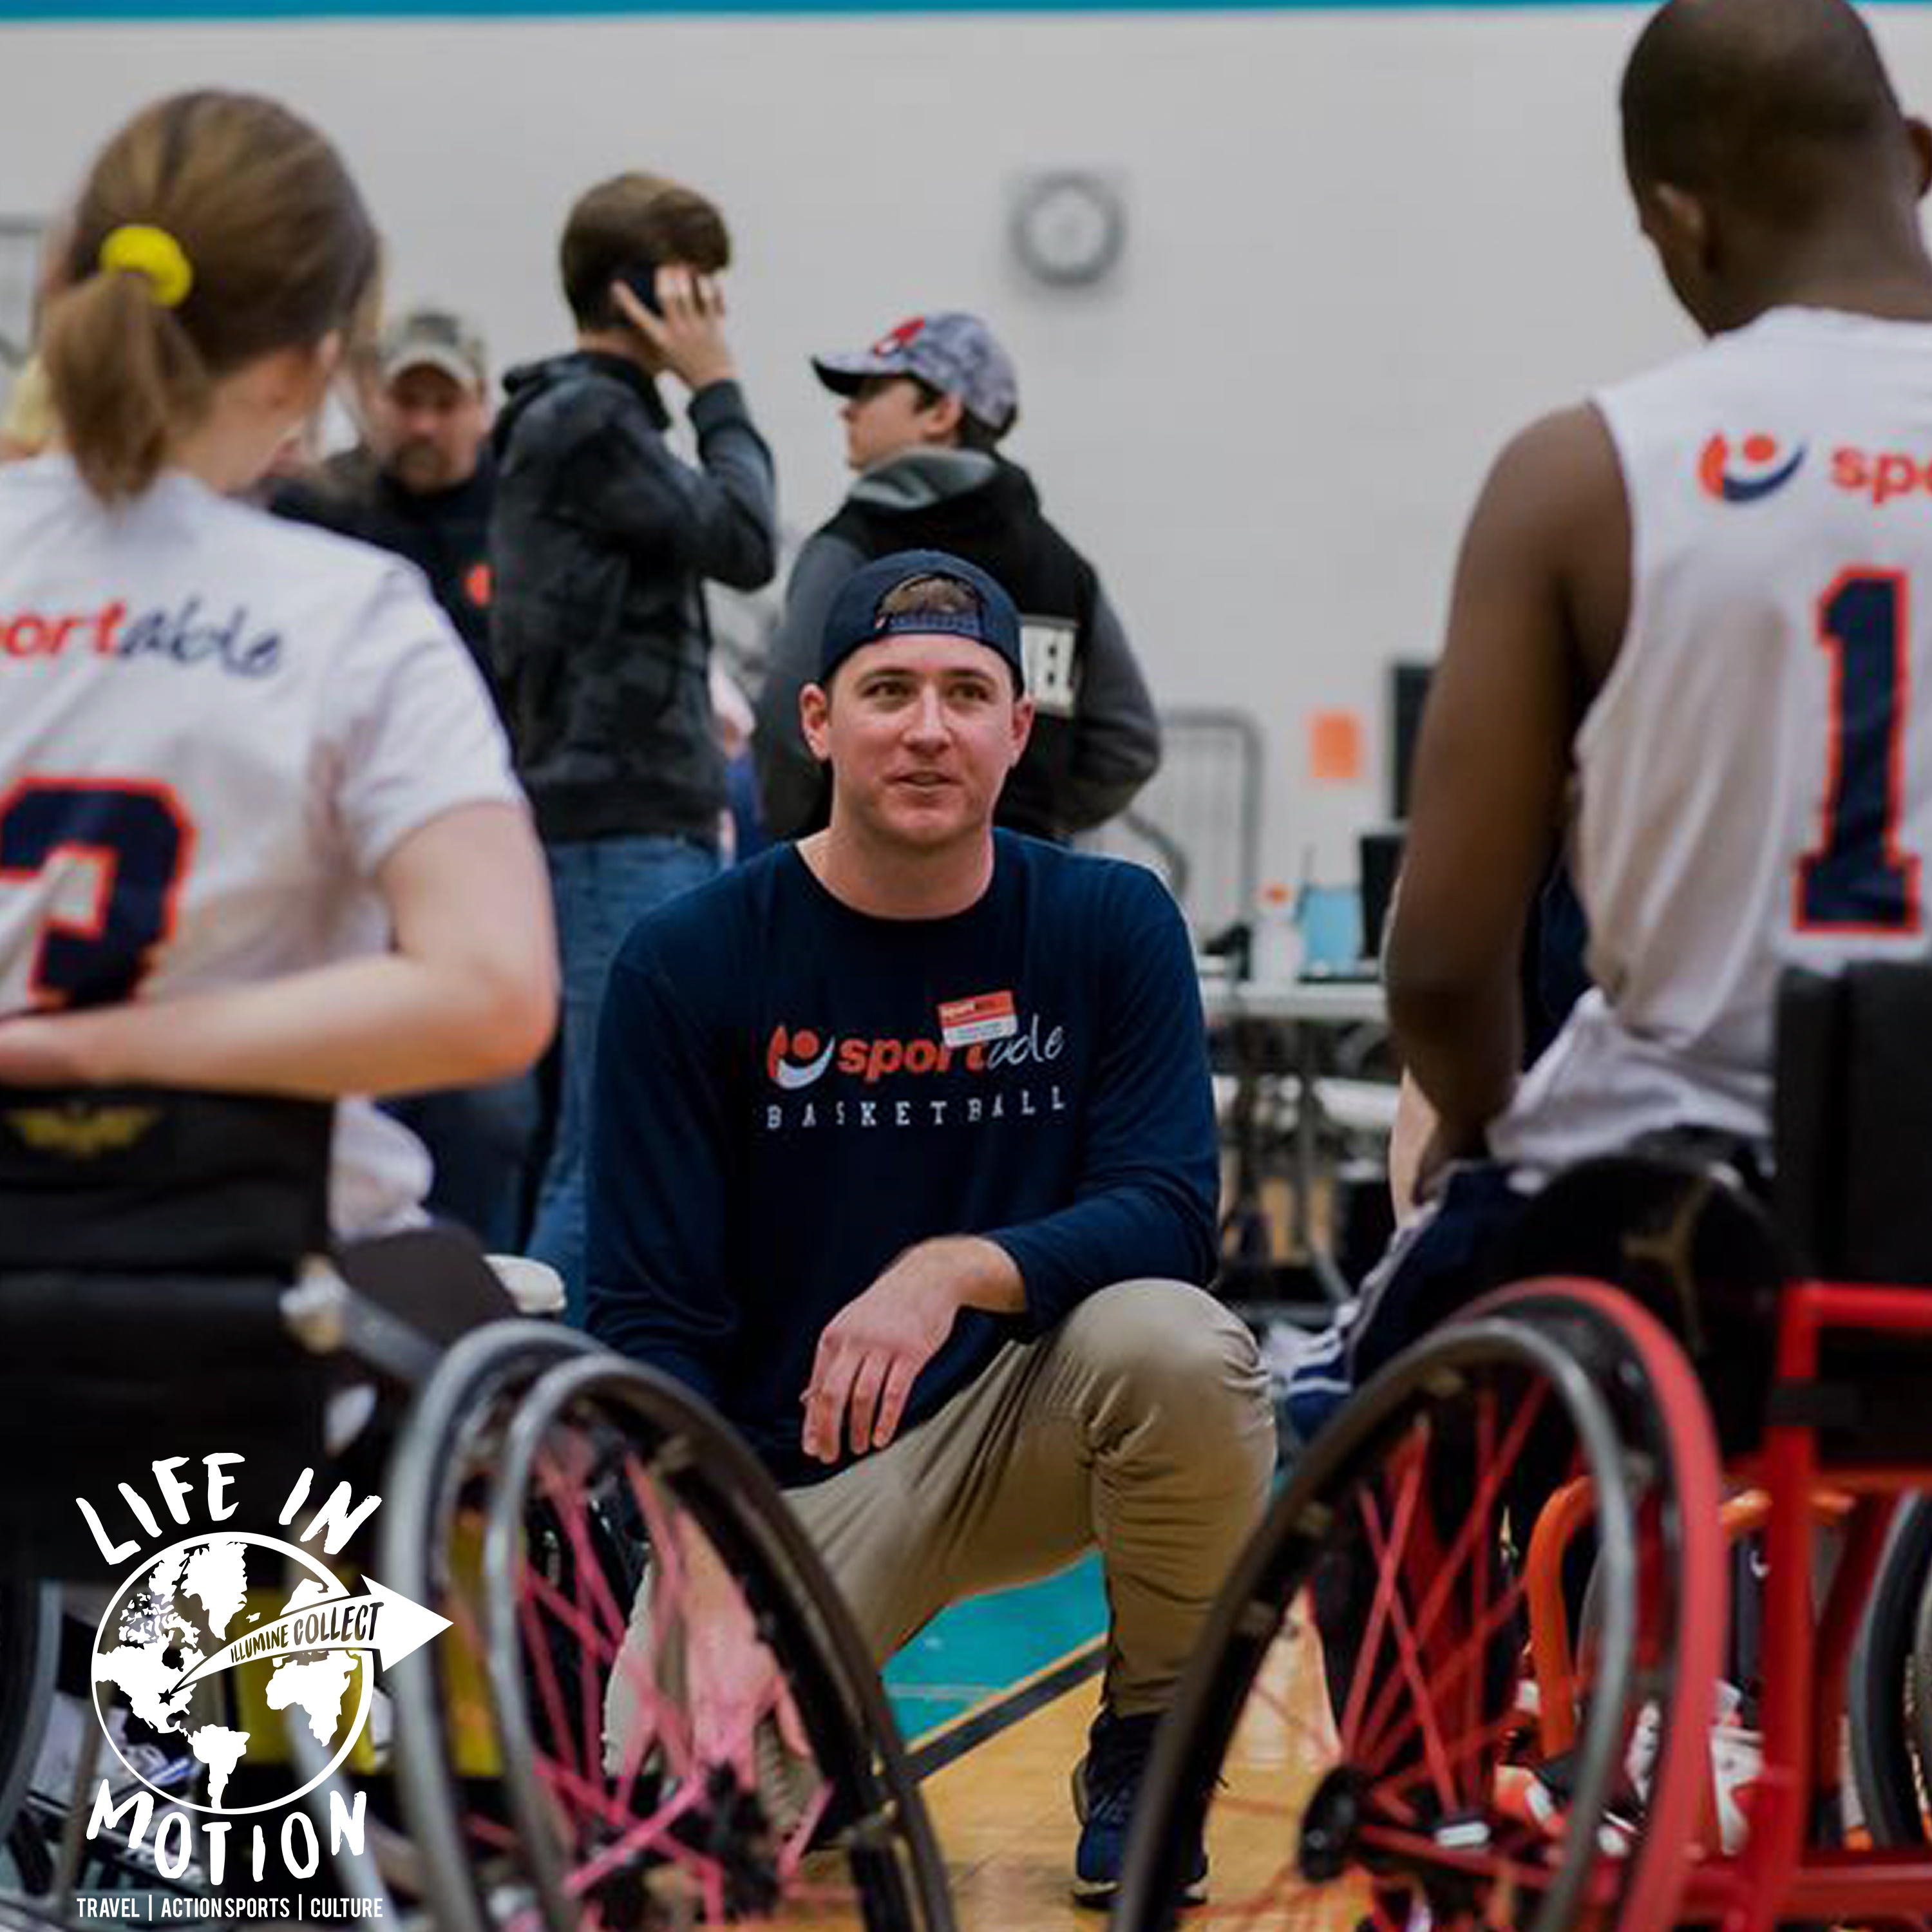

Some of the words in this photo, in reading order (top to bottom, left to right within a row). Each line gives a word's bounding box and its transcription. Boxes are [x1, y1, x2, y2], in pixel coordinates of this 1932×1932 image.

[0, 595, 282, 679] ortable
[1792, 564, 1923, 934] 1
[766, 1085, 1065, 1130] BASKETBALL
